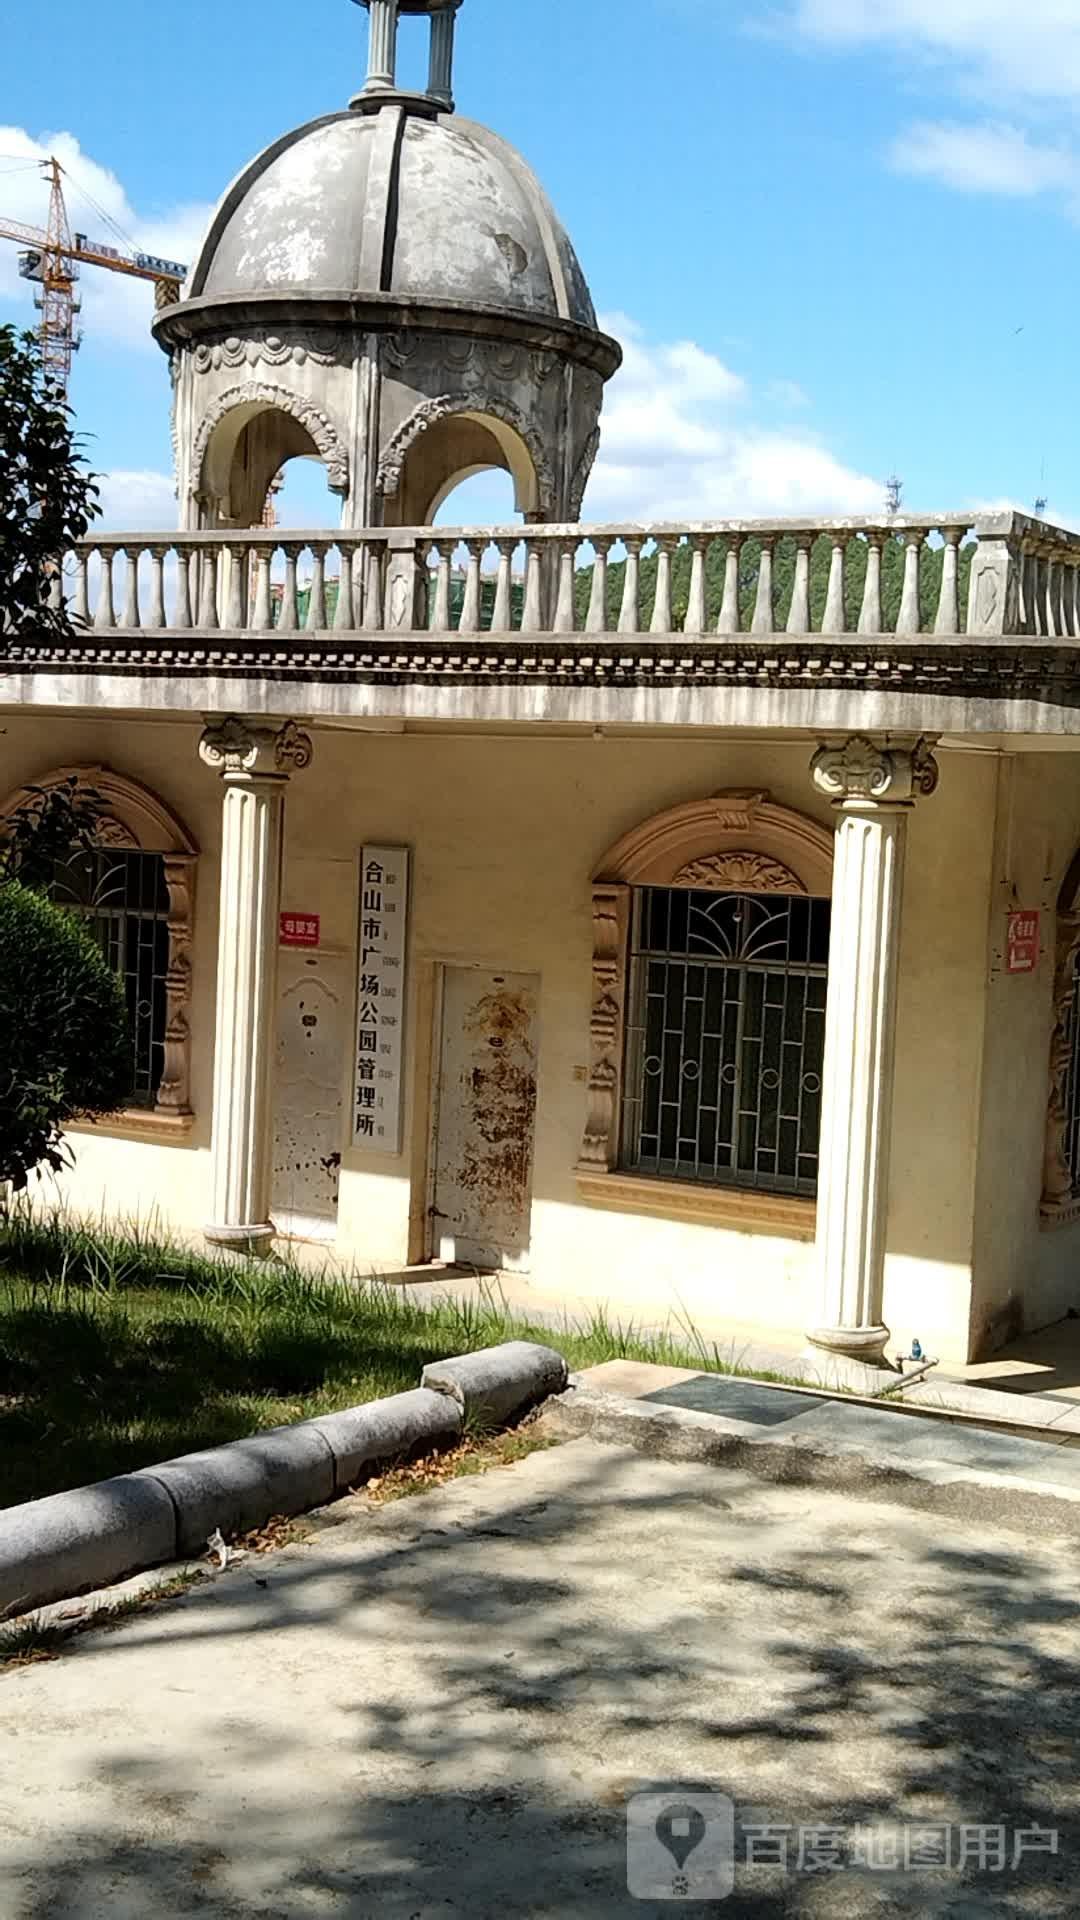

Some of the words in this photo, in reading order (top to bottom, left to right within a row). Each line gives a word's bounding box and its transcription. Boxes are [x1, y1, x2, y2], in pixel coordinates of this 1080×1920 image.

[355, 861, 384, 1137] 合山市广场公园管理所
